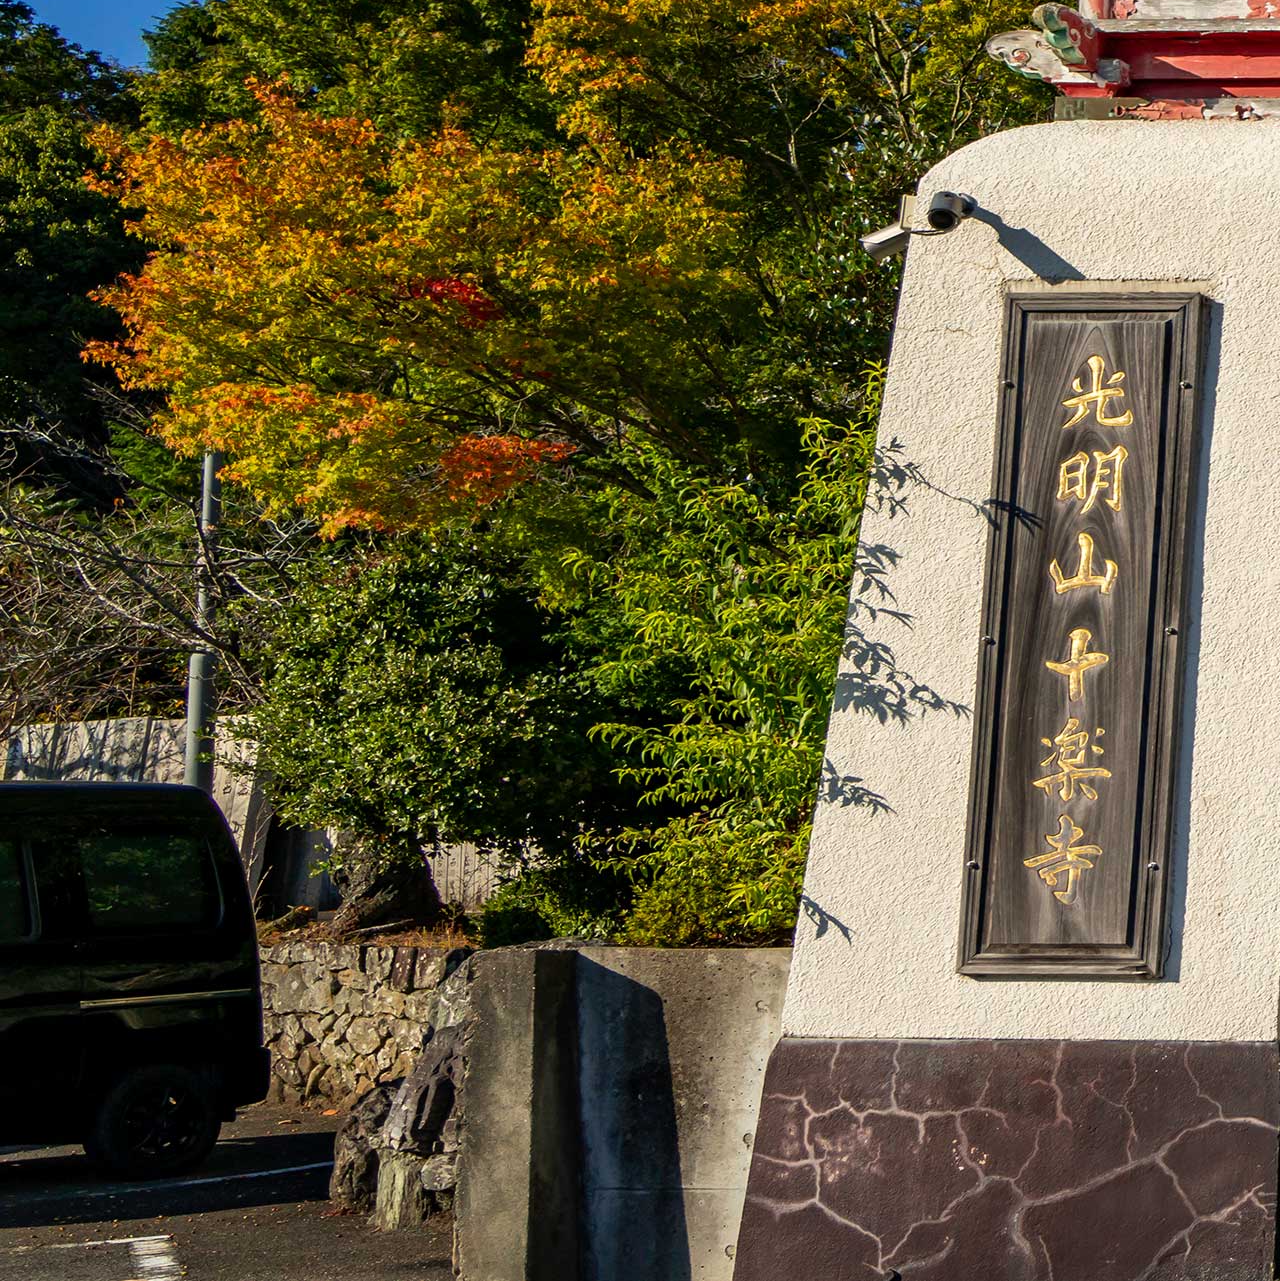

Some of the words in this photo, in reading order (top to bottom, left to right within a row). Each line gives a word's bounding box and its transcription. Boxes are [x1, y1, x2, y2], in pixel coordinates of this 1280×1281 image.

[1023, 355, 1133, 905] 光明山十楽寺
